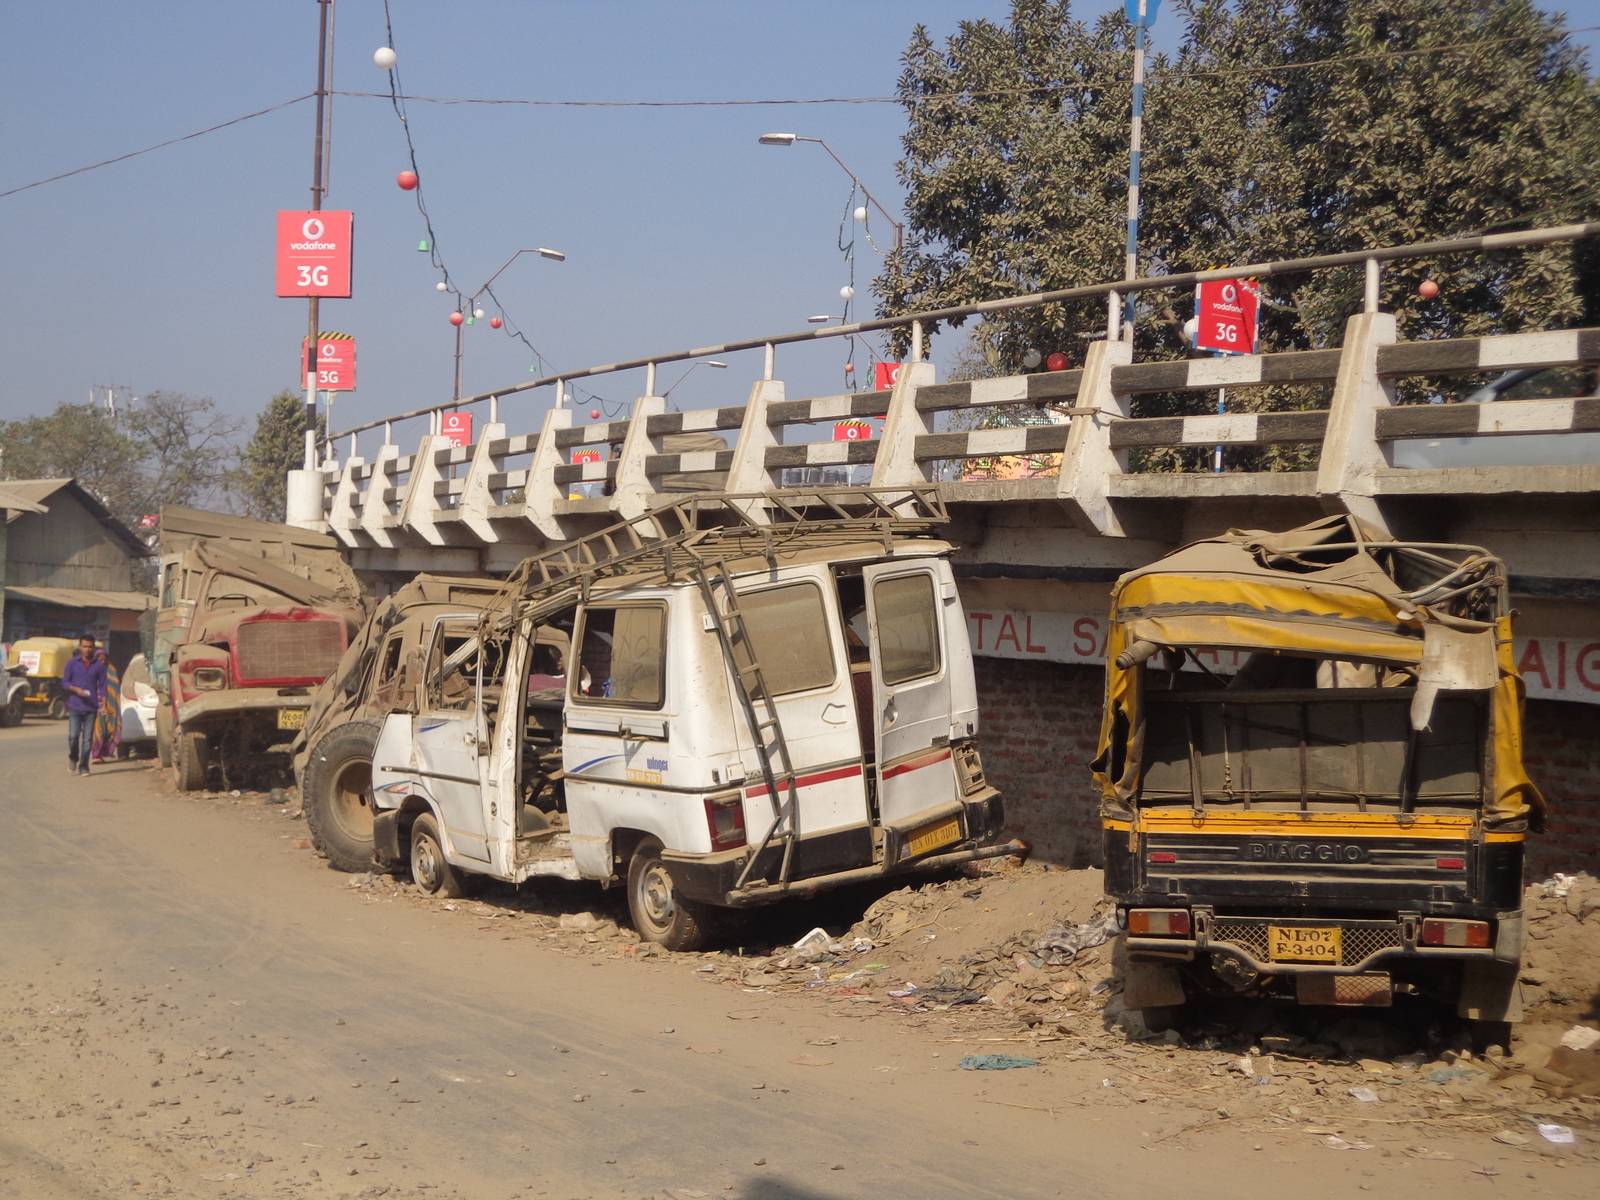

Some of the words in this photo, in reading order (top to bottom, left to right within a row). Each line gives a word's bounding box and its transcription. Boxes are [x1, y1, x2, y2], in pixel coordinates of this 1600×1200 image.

[290, 241, 336, 250] vodafone
[297, 265, 329, 287] 3G
[1212, 302, 1244, 313] vodafone
[1215, 322, 1237, 343] 3G
[319, 370, 340, 384] 3G
[1247, 842, 1362, 861] PIAGGIO
